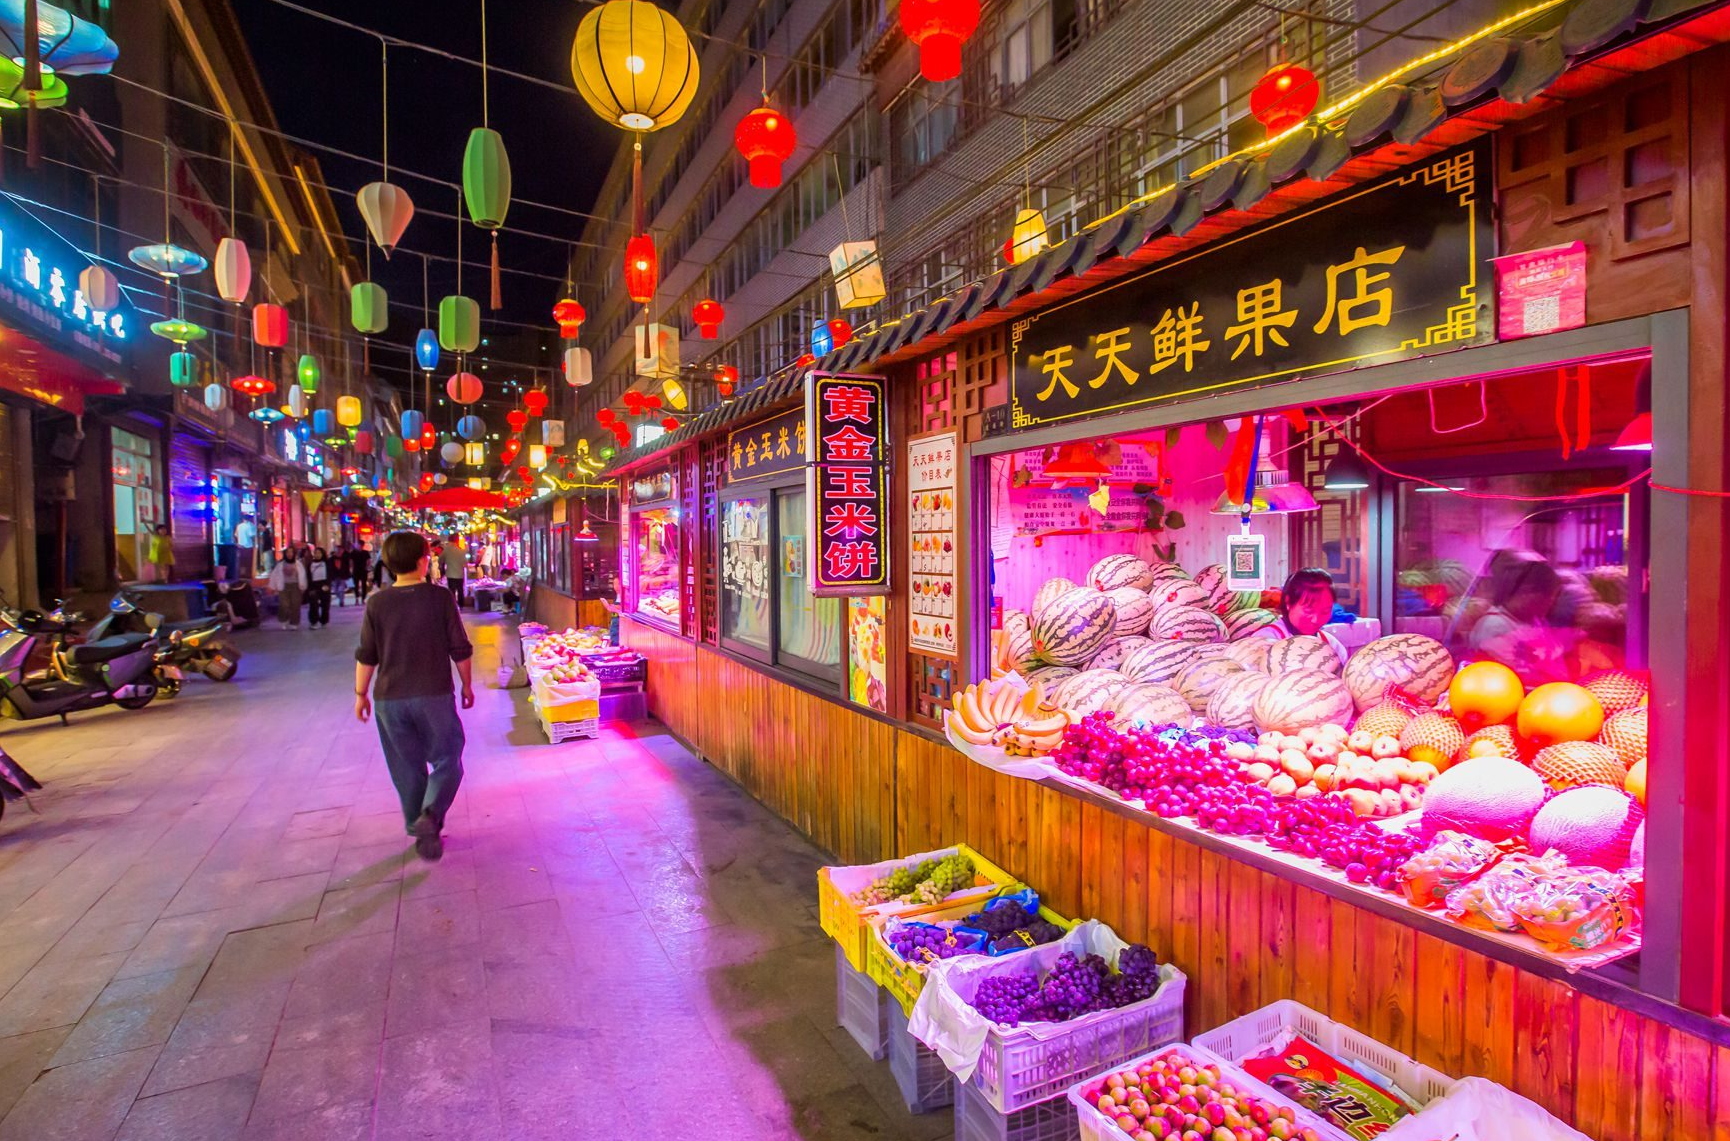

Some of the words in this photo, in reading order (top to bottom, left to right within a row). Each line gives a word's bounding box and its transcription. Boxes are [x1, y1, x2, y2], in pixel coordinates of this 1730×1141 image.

[1036, 245, 1406, 401] 天天鲜果店
[824, 386, 878, 578] 黄金玉米饼
[912, 448, 952, 467] 天天鲜果店
